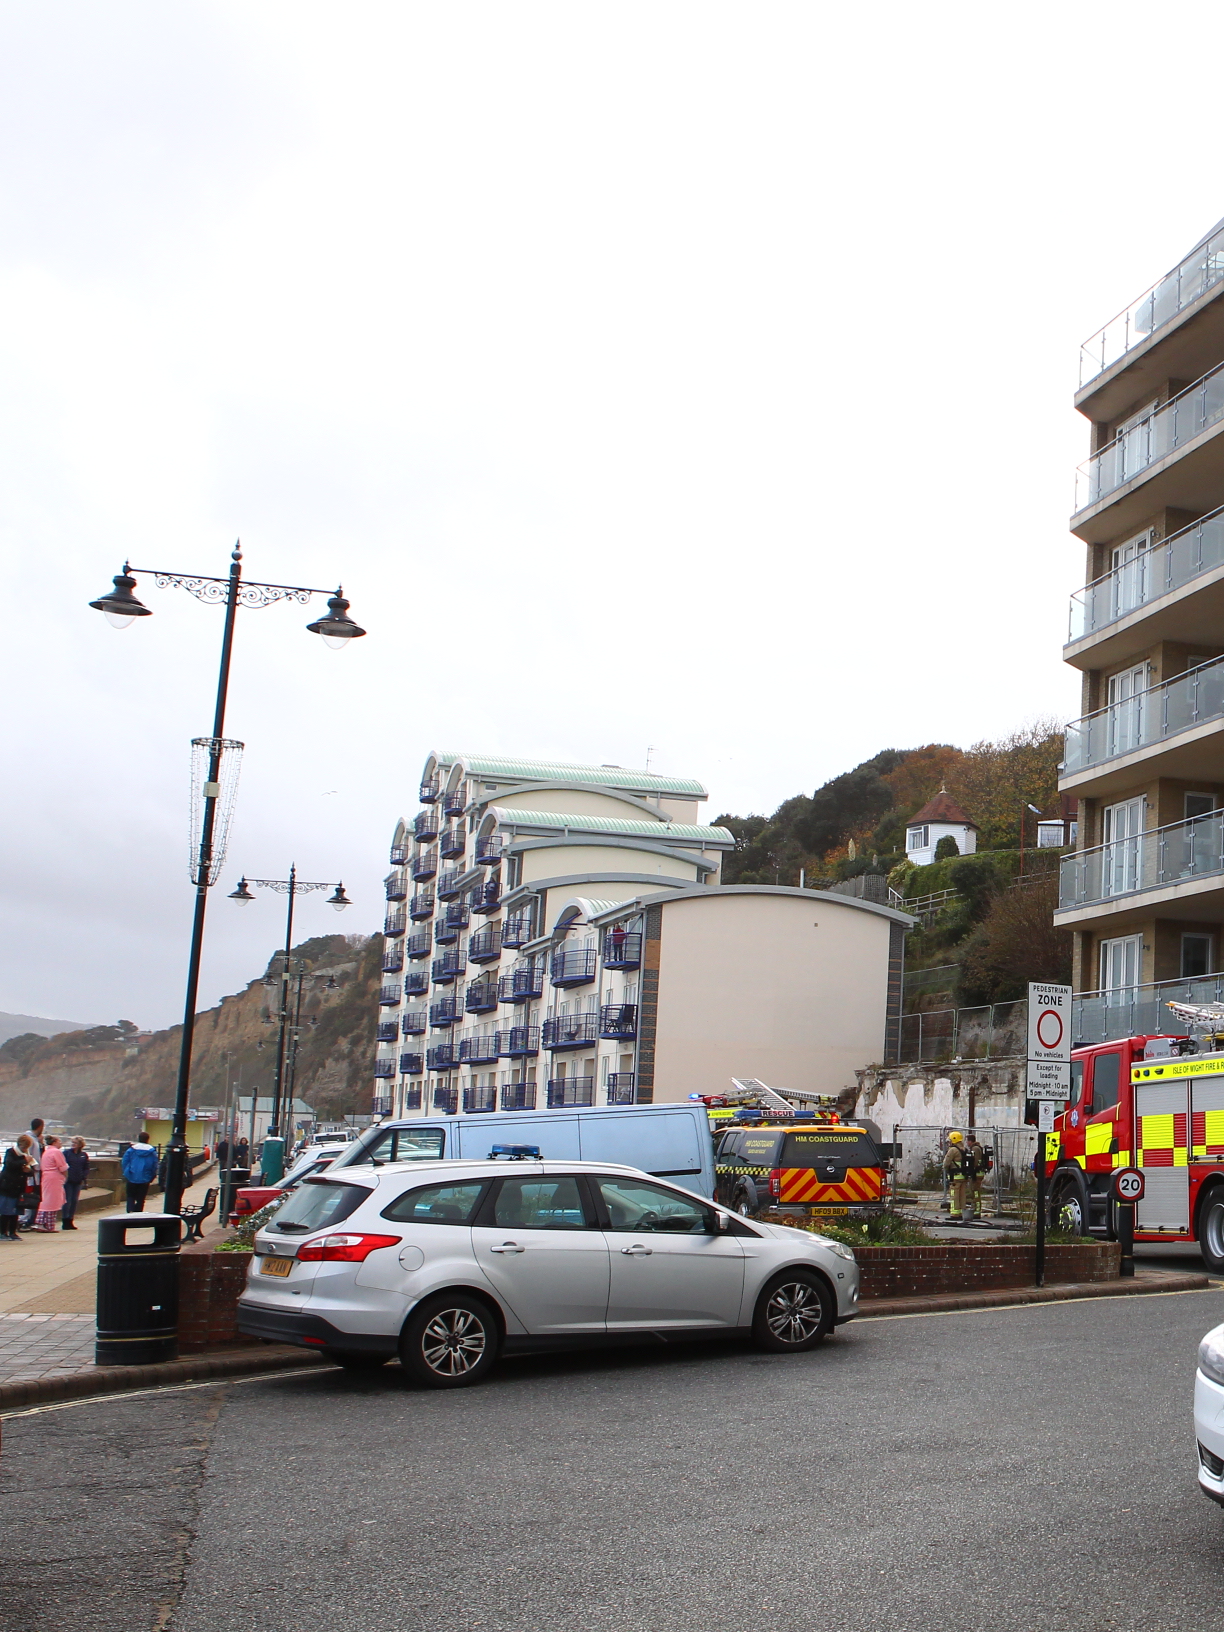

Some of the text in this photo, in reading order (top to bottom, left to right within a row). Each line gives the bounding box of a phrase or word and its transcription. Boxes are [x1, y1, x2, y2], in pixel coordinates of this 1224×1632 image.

[1033, 985, 1068, 994] PEDESTRIAN
[1037, 994, 1063, 1006] ZONE
[1036, 1064, 1053, 1072] Except
[1172, 1066, 1182, 1075] ISLE
[1182, 1065, 1189, 1073] OF
[1190, 1063, 1205, 1072] WIGHT
[1205, 1062, 1215, 1071] FIRE
[1039, 1072, 1058, 1080] loading
[1029, 1081, 1051, 1090] Midnight
[1045, 1090, 1067, 1098] Midnight
[1121, 1178, 1140, 1191] 20
